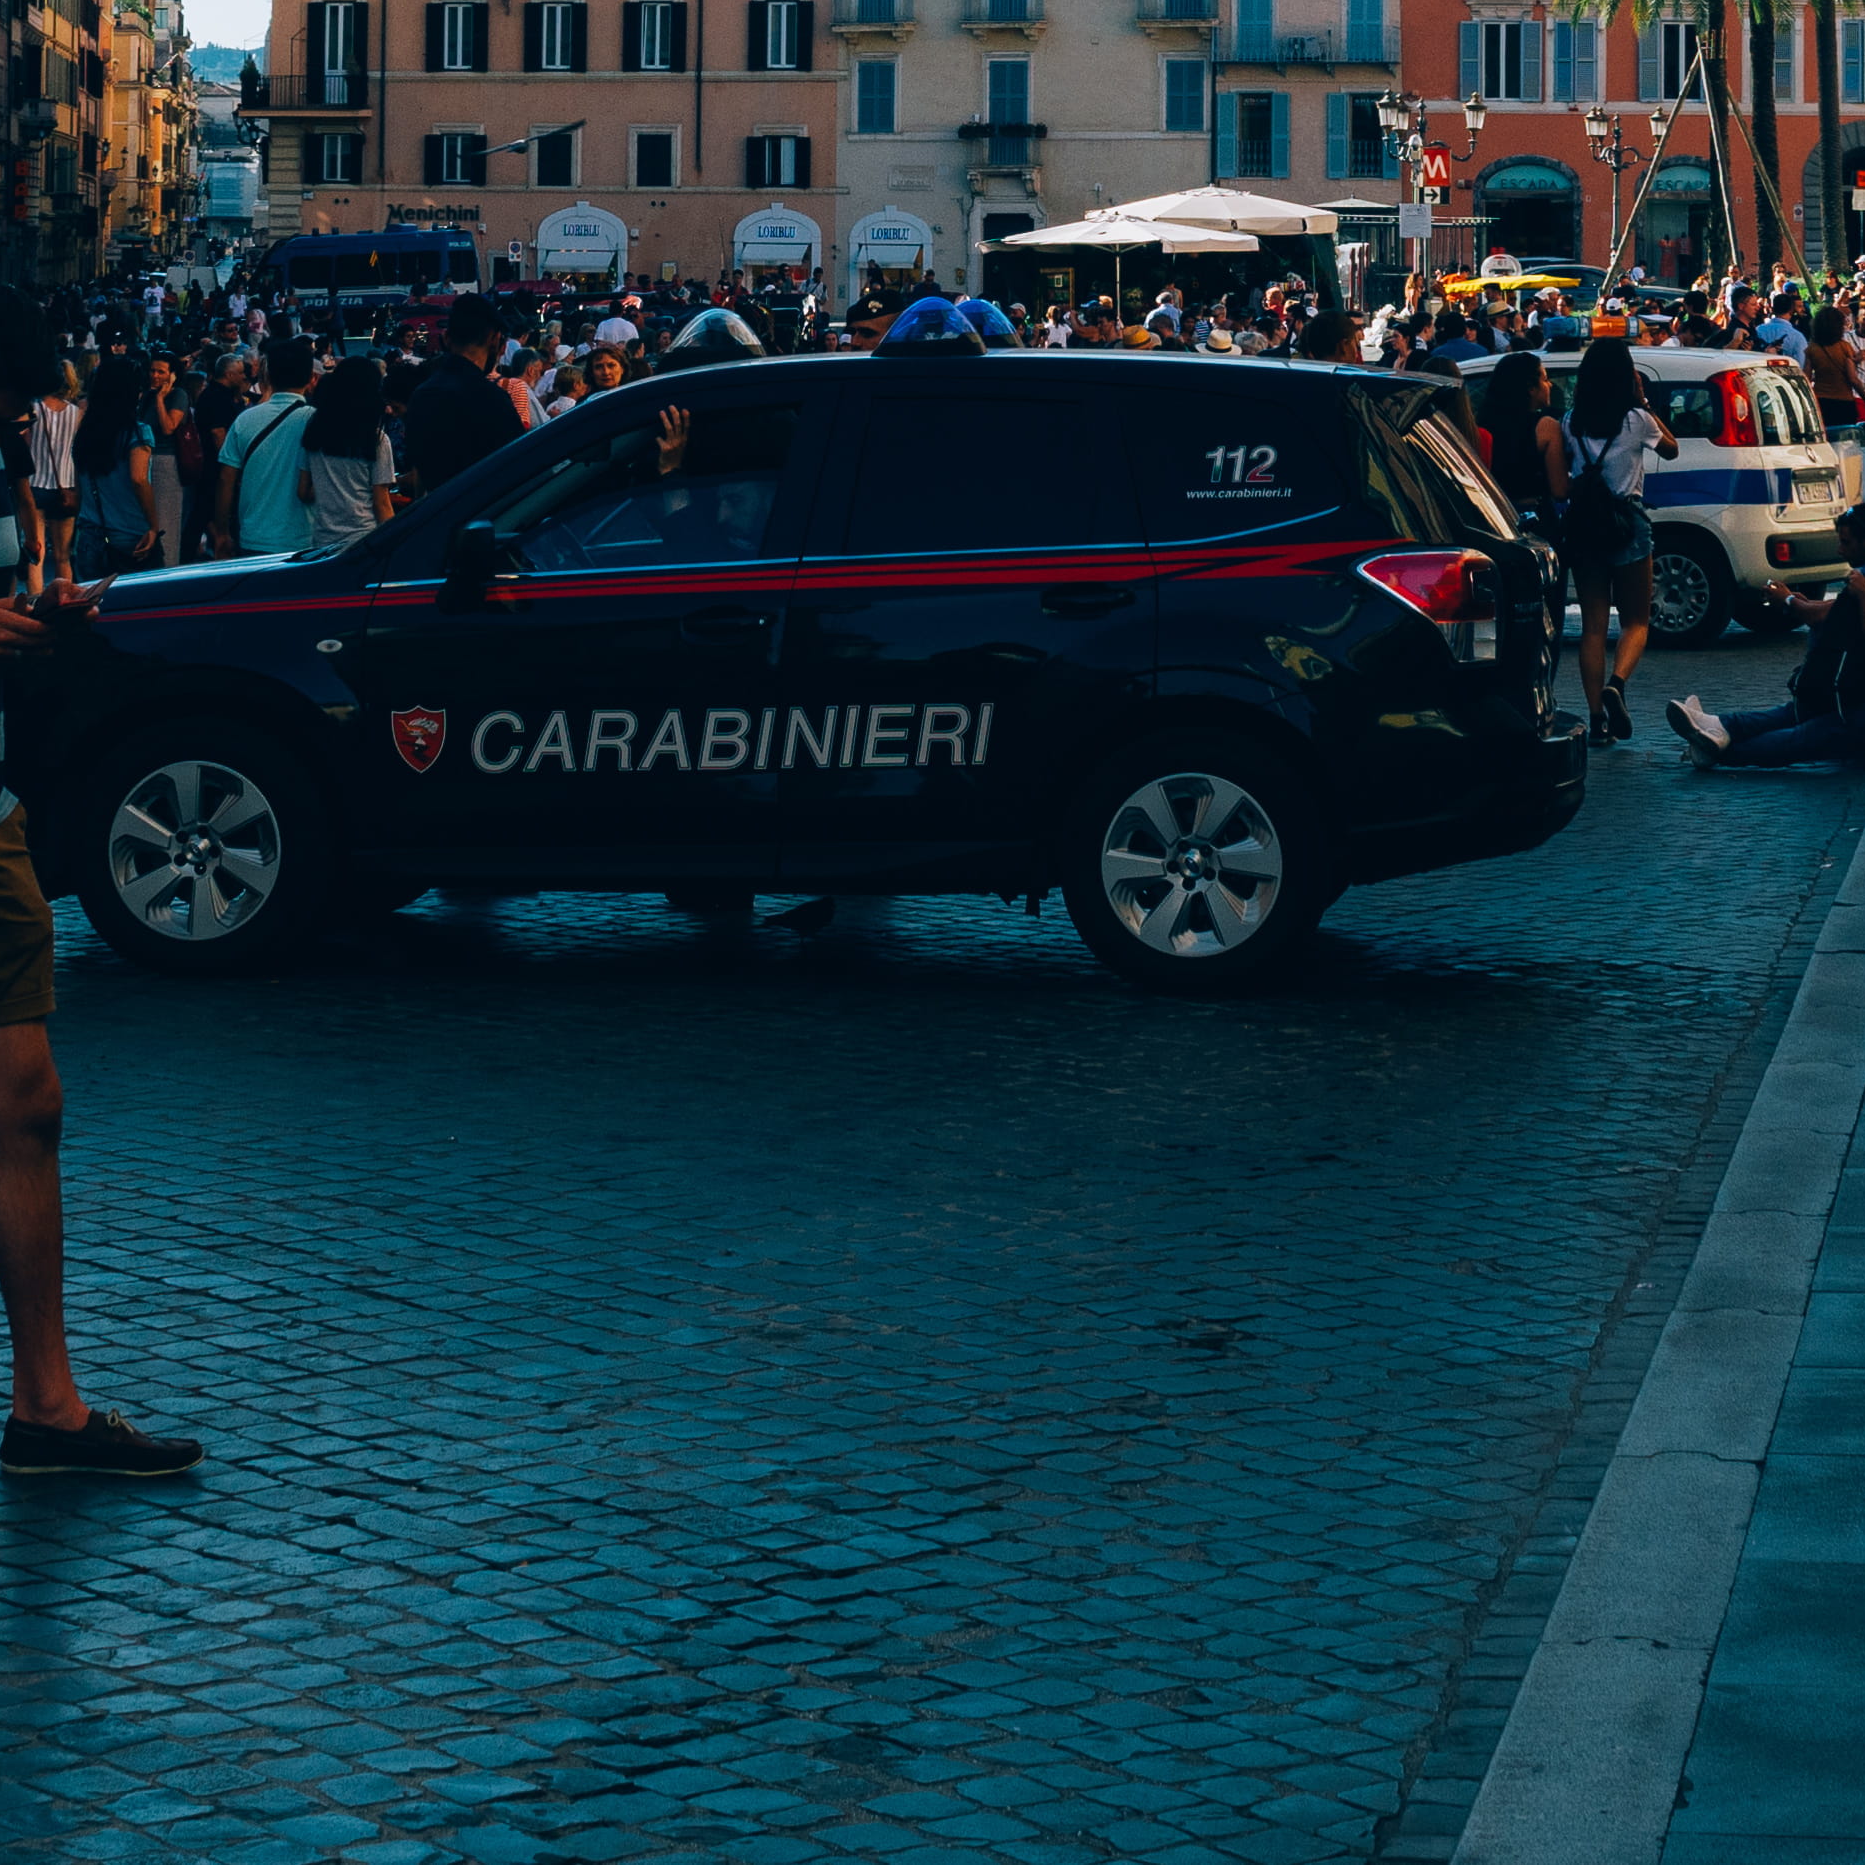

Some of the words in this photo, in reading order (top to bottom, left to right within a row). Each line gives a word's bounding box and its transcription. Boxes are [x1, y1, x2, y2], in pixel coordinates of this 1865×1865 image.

[1500, 178, 1559, 191] ESCADA
[387, 203, 480, 223] Menichini
[563, 223, 600, 237] LORIBLU
[758, 225, 796, 239] LORIBLU
[871, 227, 910, 241] LORIBLU
[1205, 444, 1278, 483] 112
[1186, 487, 1292, 499] www.carabinieri.it
[470, 702, 994, 774] CARABINIERI
